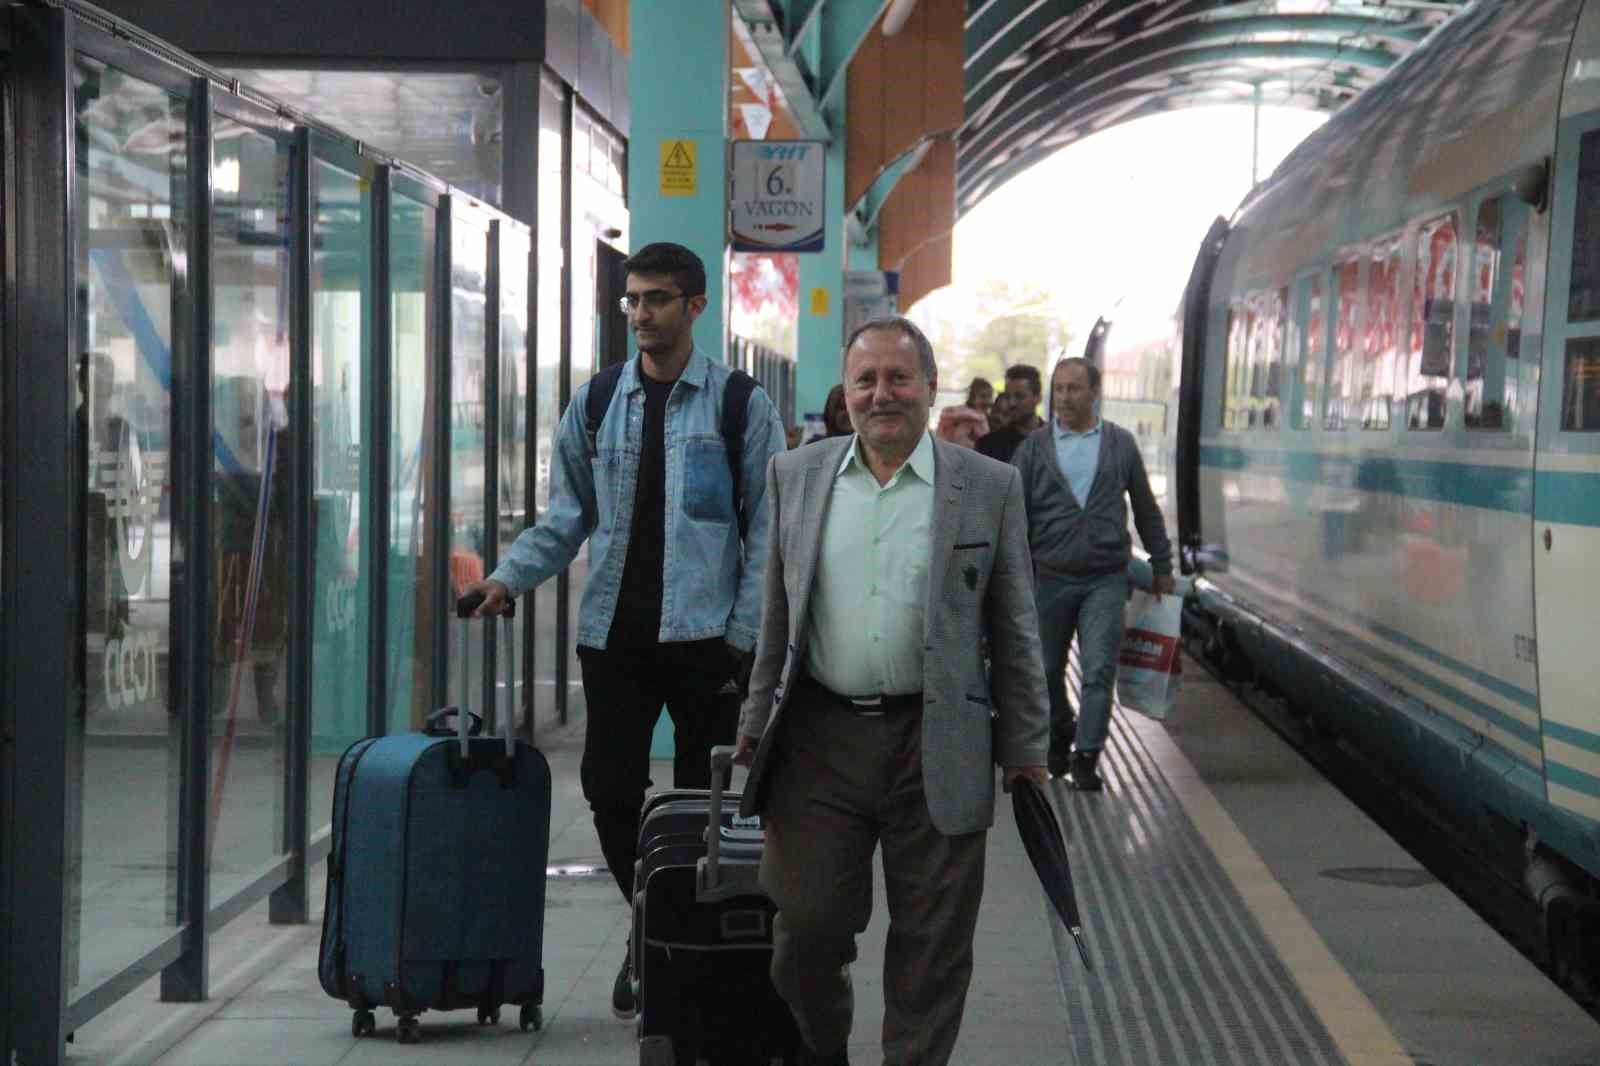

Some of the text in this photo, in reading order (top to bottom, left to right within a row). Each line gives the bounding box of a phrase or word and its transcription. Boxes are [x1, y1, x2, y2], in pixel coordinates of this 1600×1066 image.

[761, 145, 811, 160] YHT
[767, 165, 792, 196] 6.
[744, 200, 814, 217] VAGON
